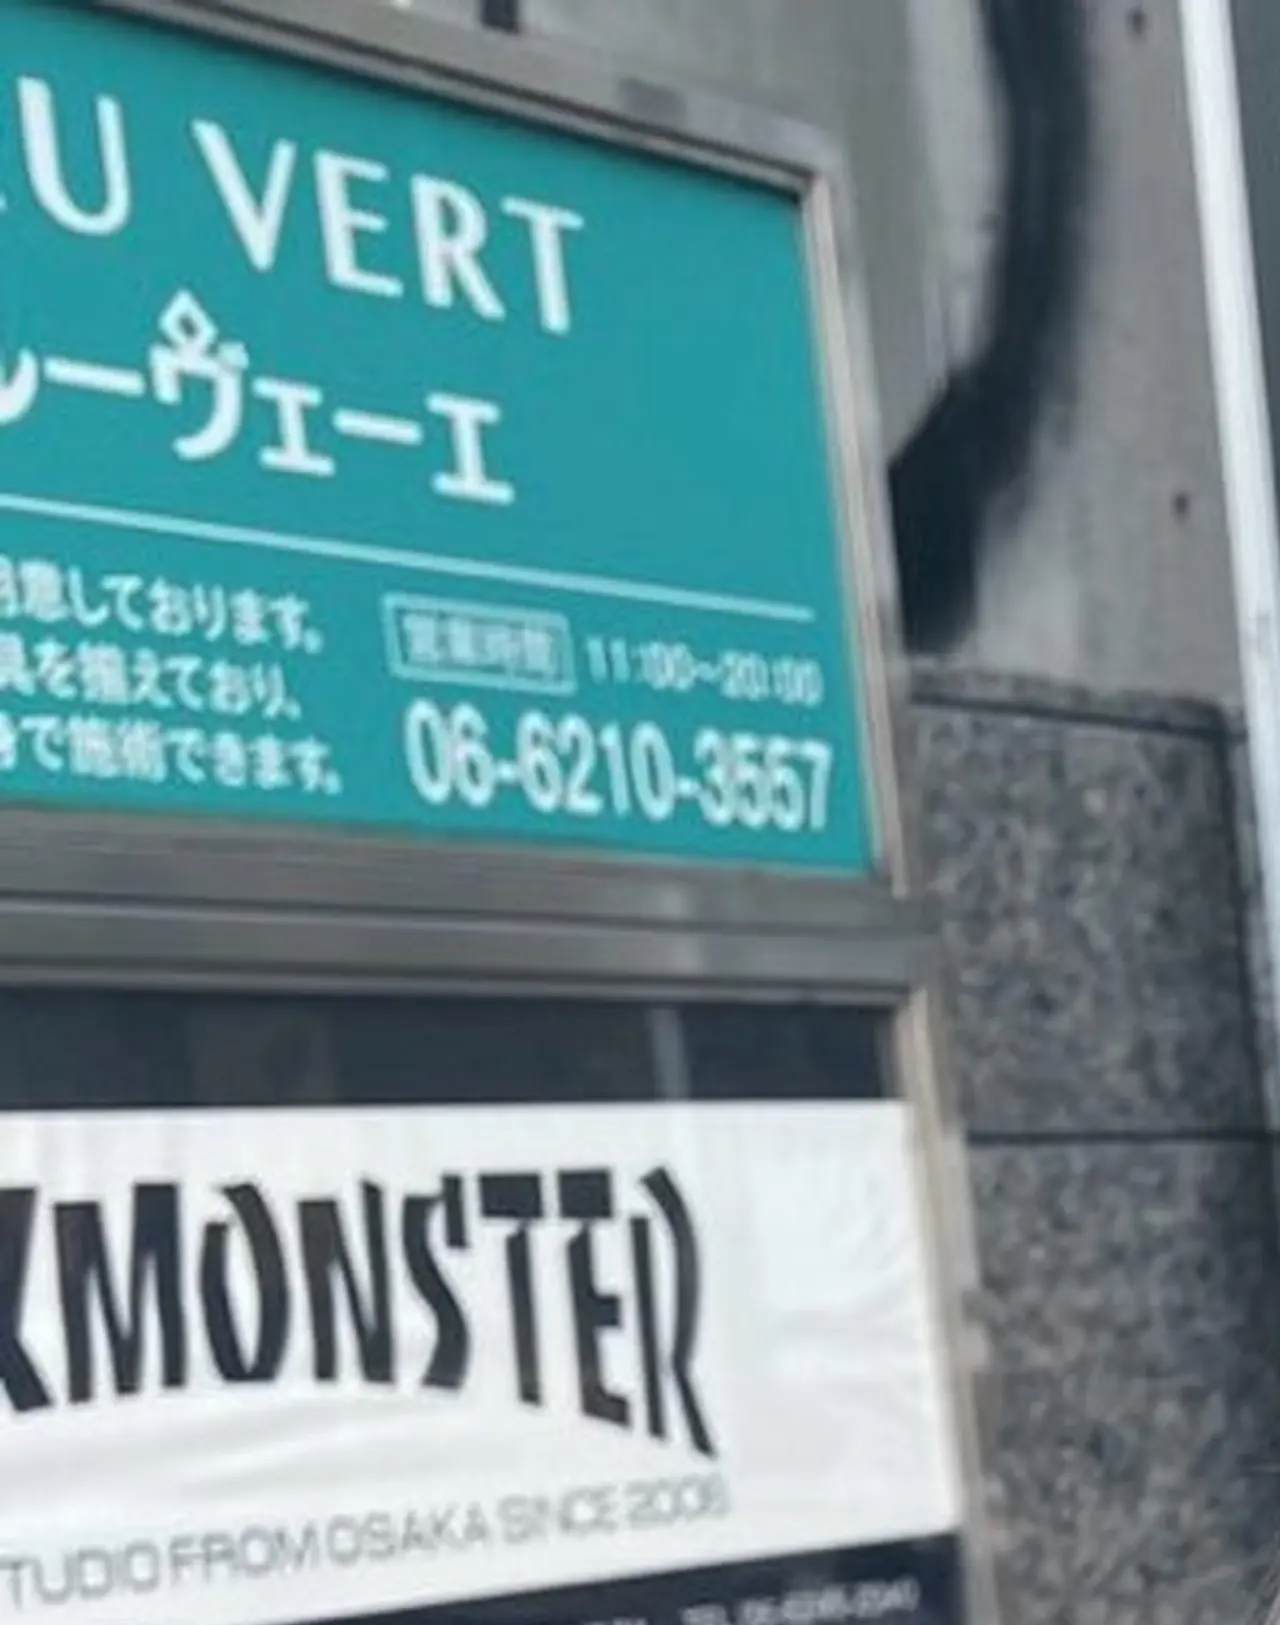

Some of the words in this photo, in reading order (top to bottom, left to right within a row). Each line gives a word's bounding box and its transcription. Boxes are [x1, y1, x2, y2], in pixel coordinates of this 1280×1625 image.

[192, 118, 585, 335] VERT
[169, 1524, 321, 1587] FROM
[326, 1500, 491, 1567] OSAKA
[497, 1480, 621, 1541] SINCE
